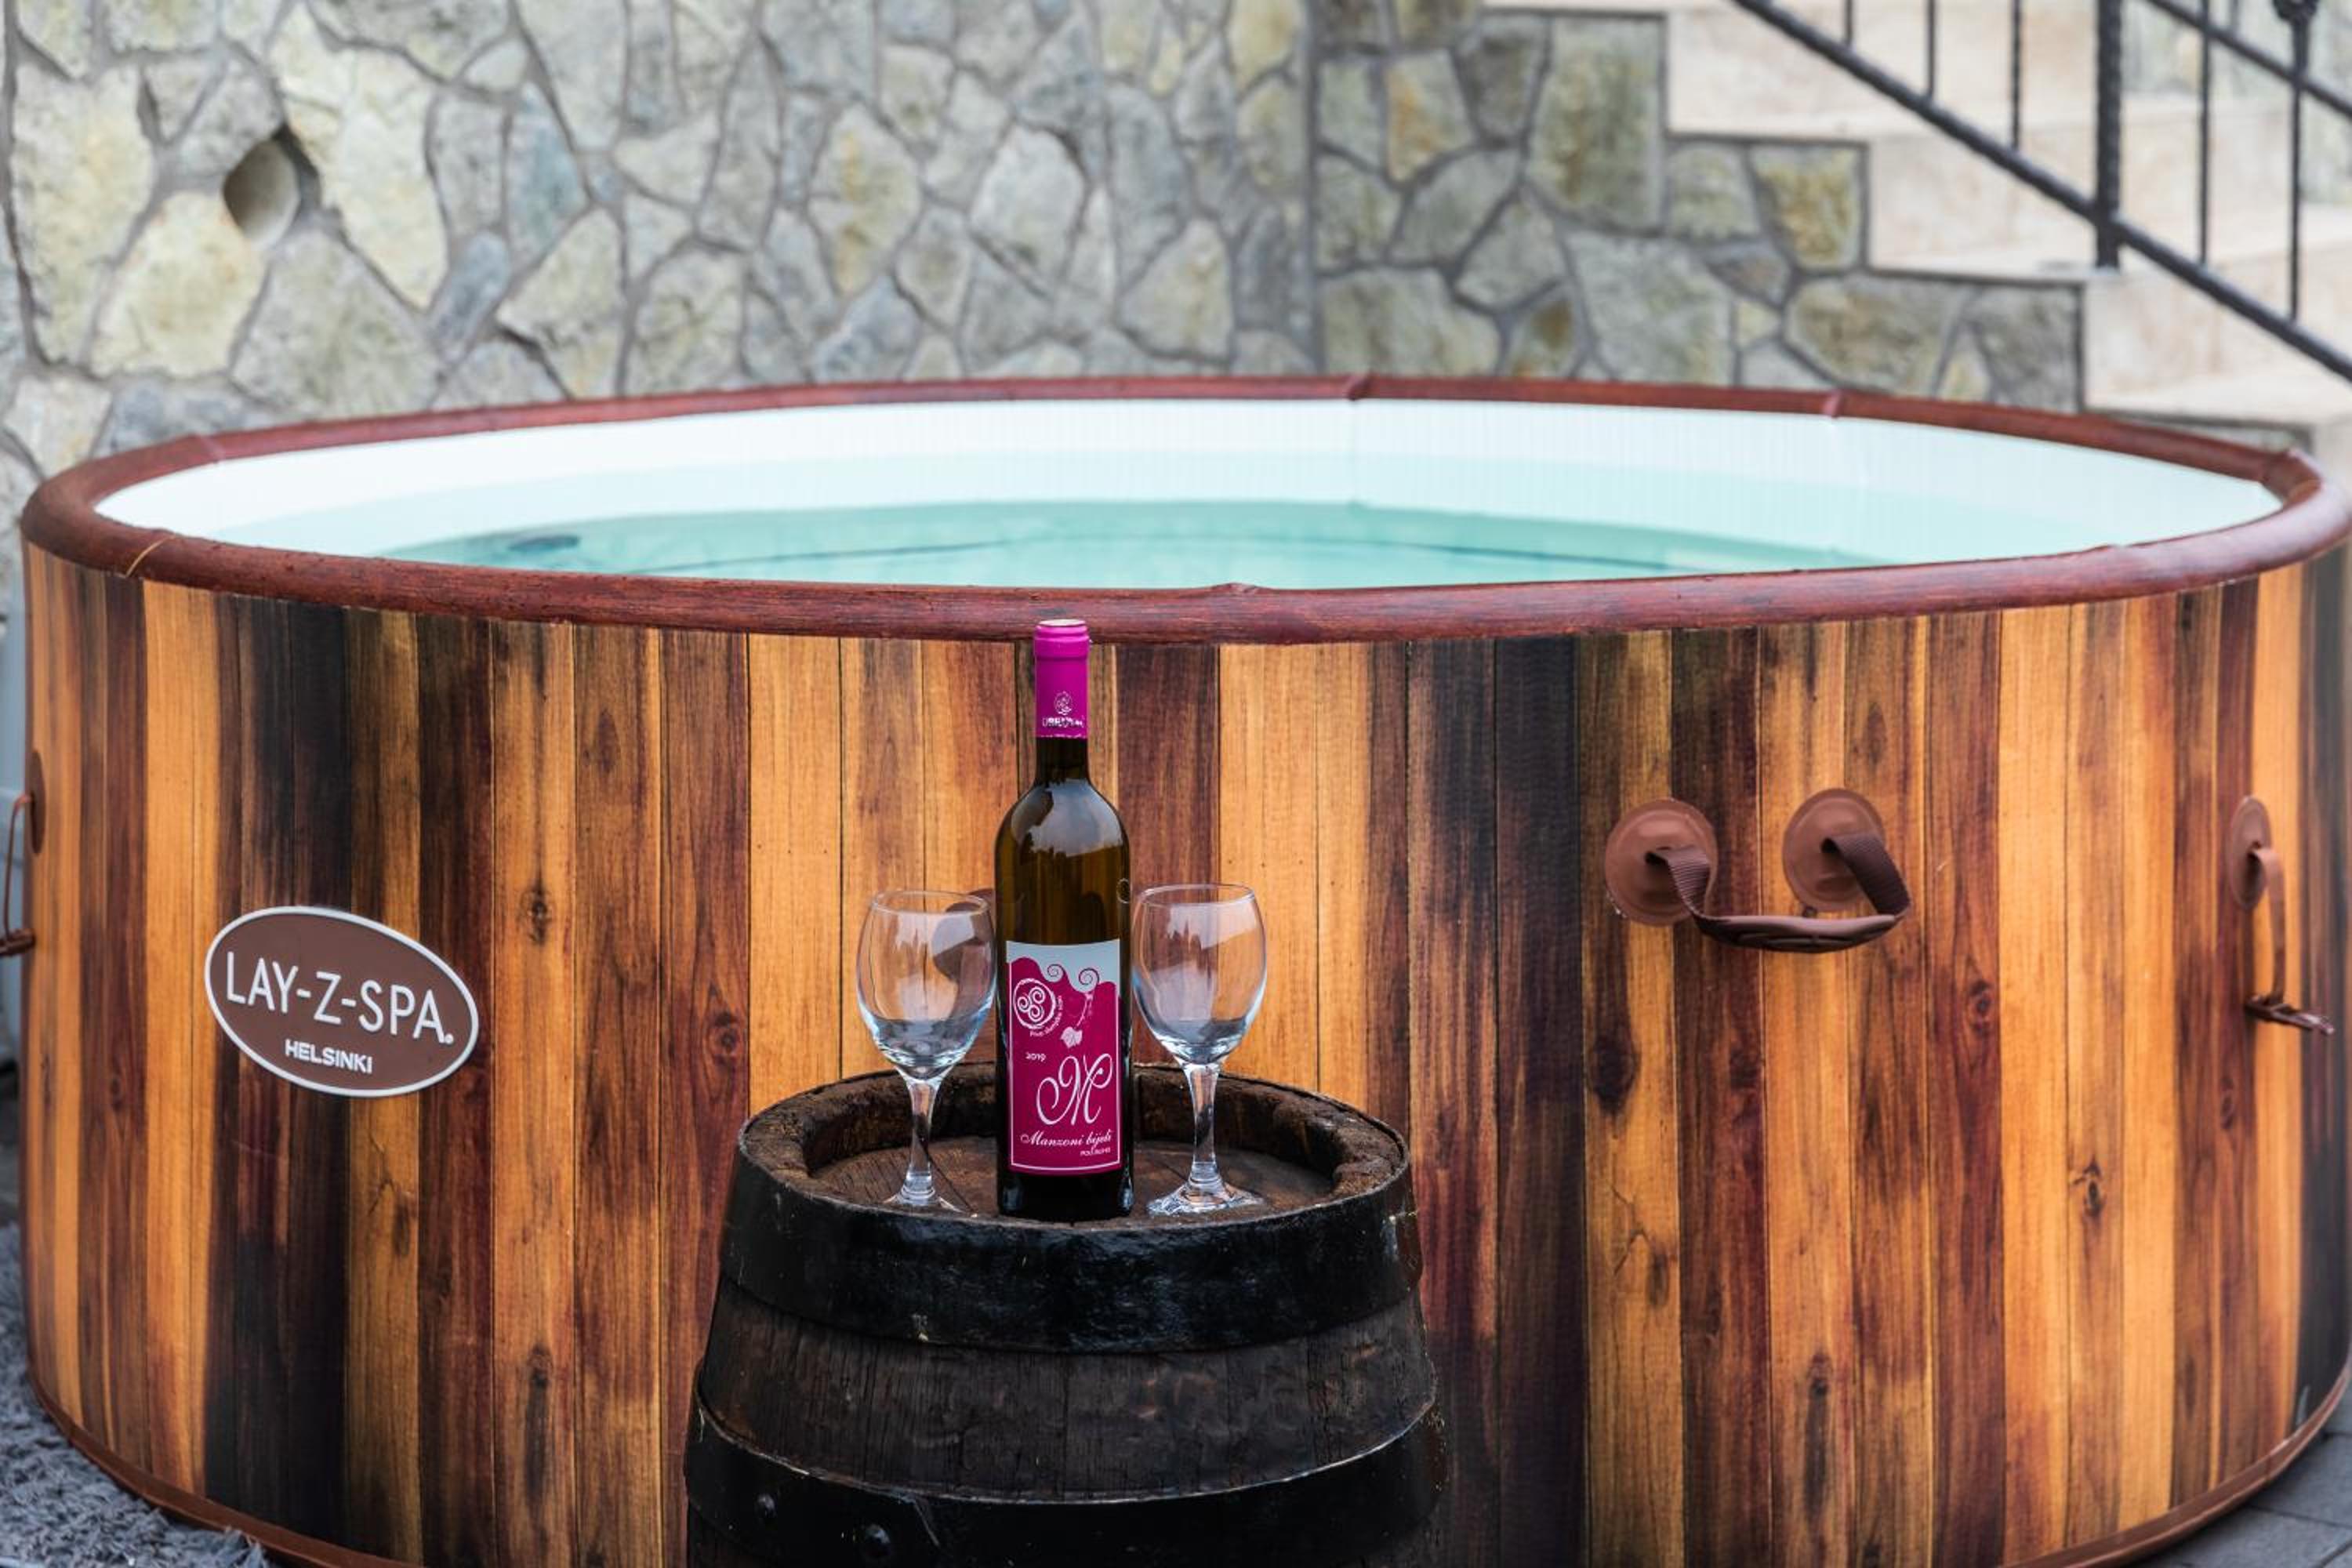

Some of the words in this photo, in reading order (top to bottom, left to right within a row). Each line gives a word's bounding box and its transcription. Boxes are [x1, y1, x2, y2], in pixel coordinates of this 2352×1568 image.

[285, 1039, 372, 1074] HELSINKI
[1025, 1051, 1047, 1062] 2019
[1020, 1130, 1083, 1146] Manzoni
